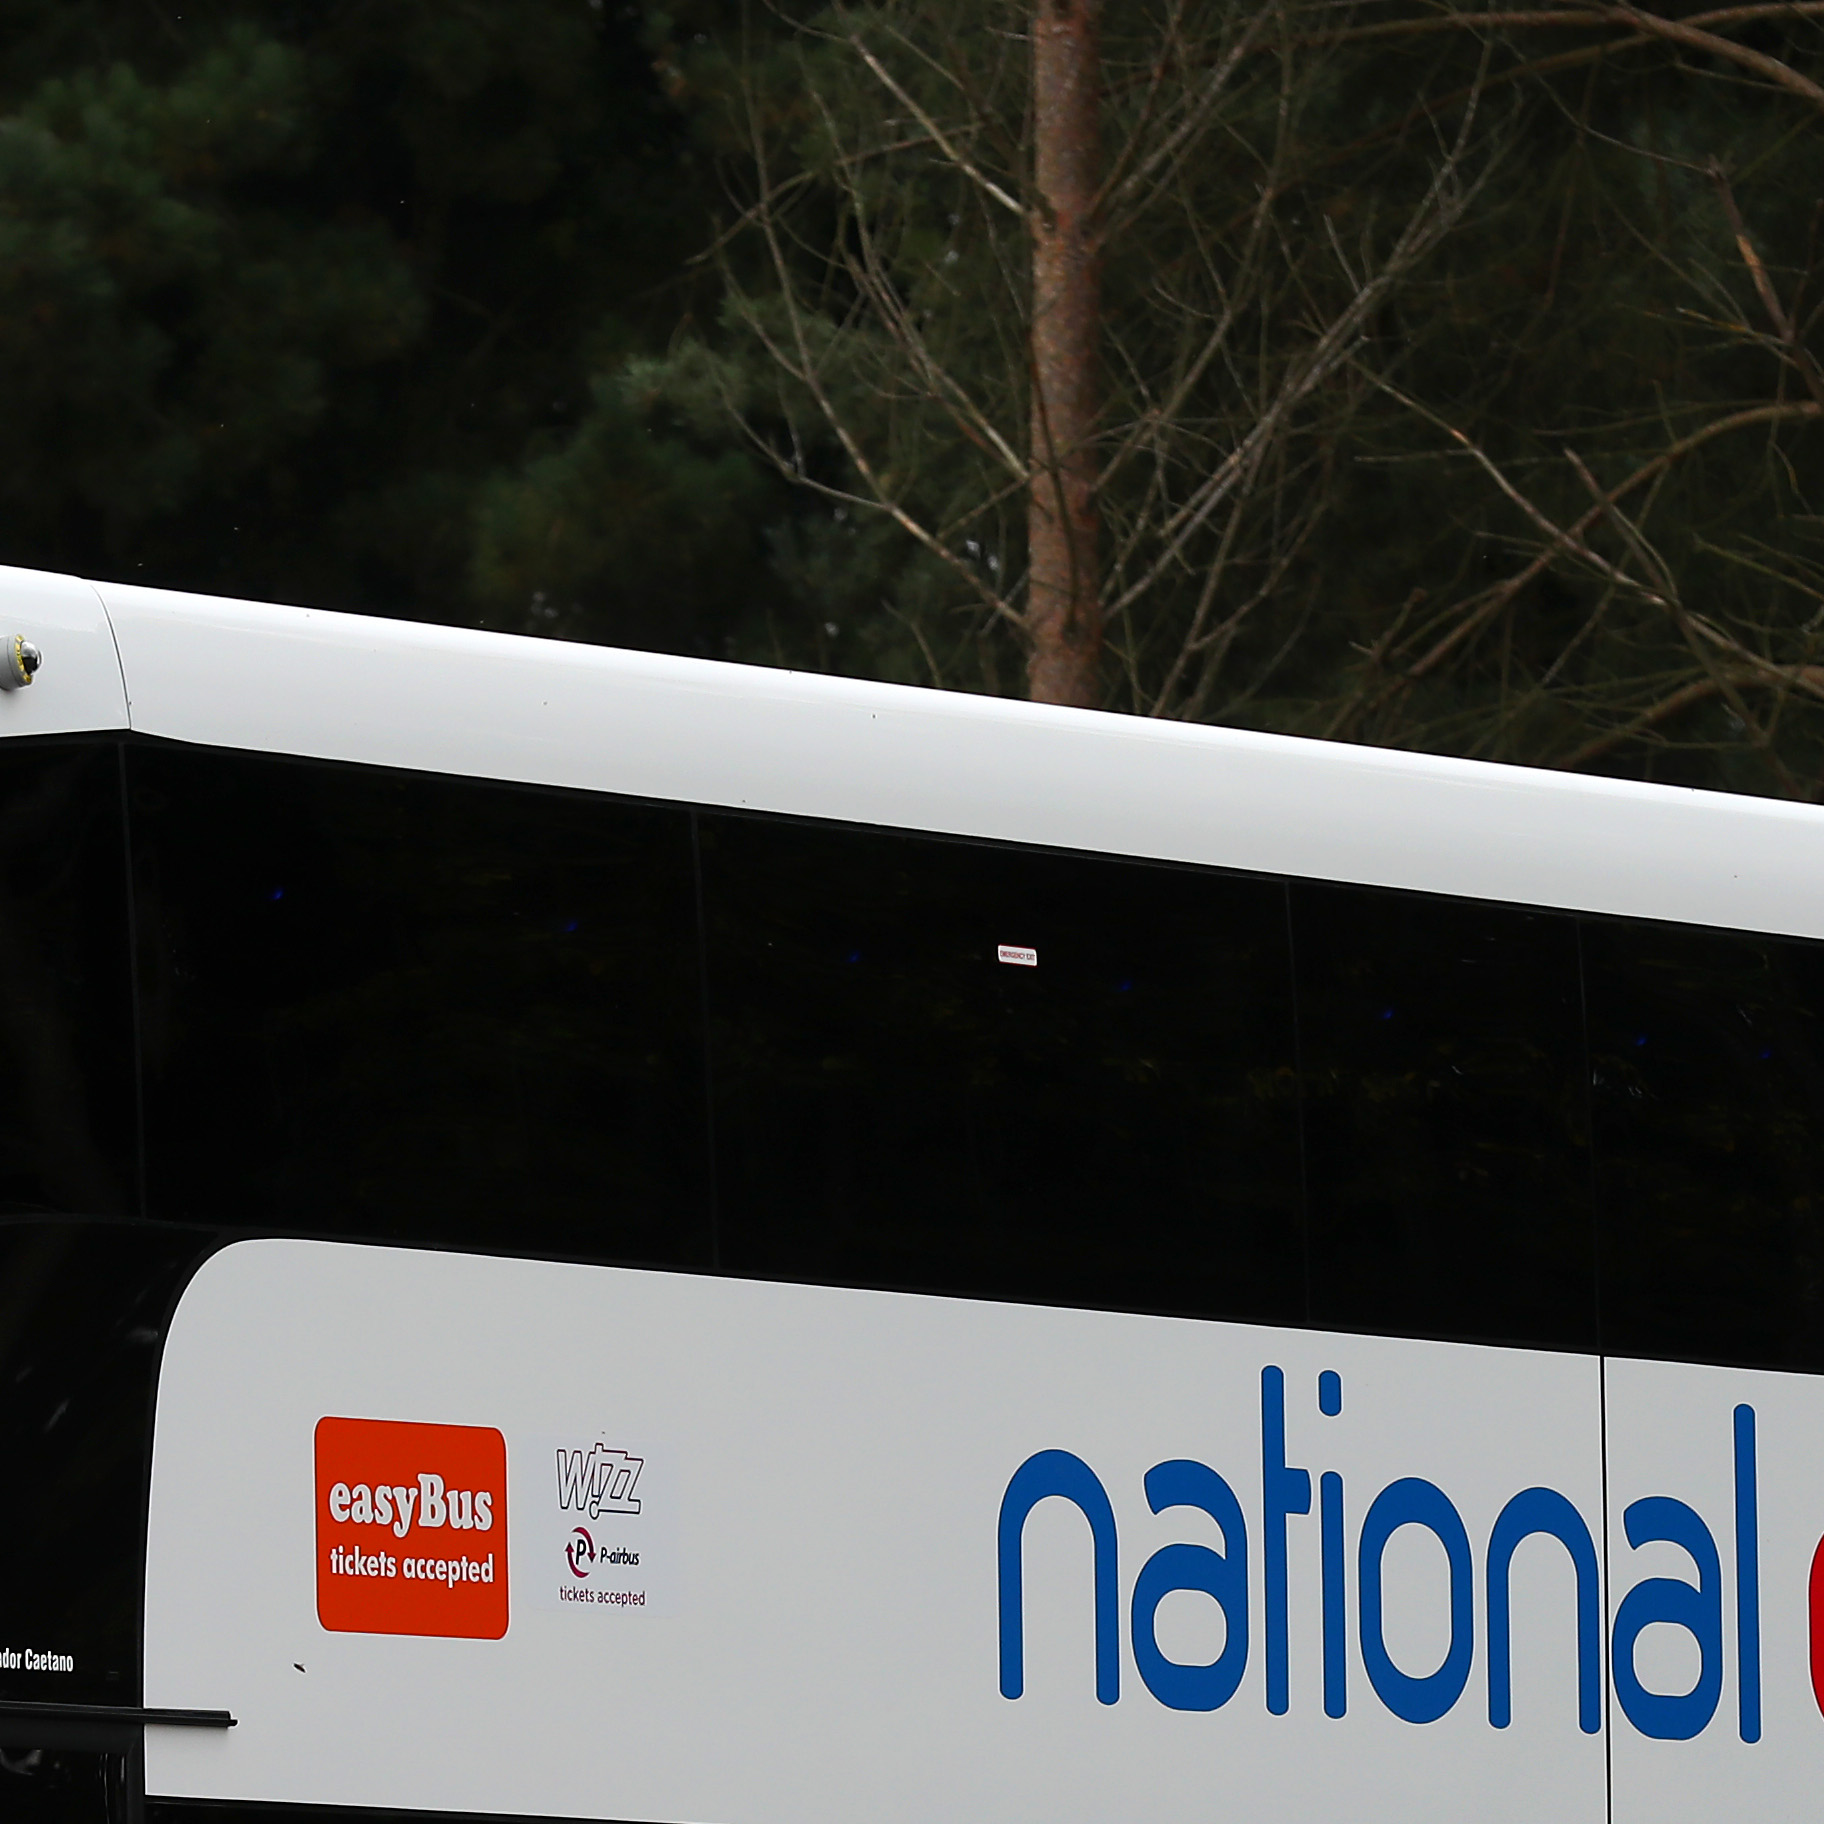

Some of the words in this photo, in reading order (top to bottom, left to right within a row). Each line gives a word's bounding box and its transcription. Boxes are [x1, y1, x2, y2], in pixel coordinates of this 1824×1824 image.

[329, 1473, 493, 1538] easyBus
[330, 1545, 397, 1578] tickets
[402, 1552, 494, 1589] accepted
[599, 1546, 640, 1566] P-airbus
[999, 1366, 1762, 1743] national
[559, 1585, 595, 1603] tickets
[597, 1590, 646, 1608] accepted
[24, 1648, 74, 1672] Caetano
